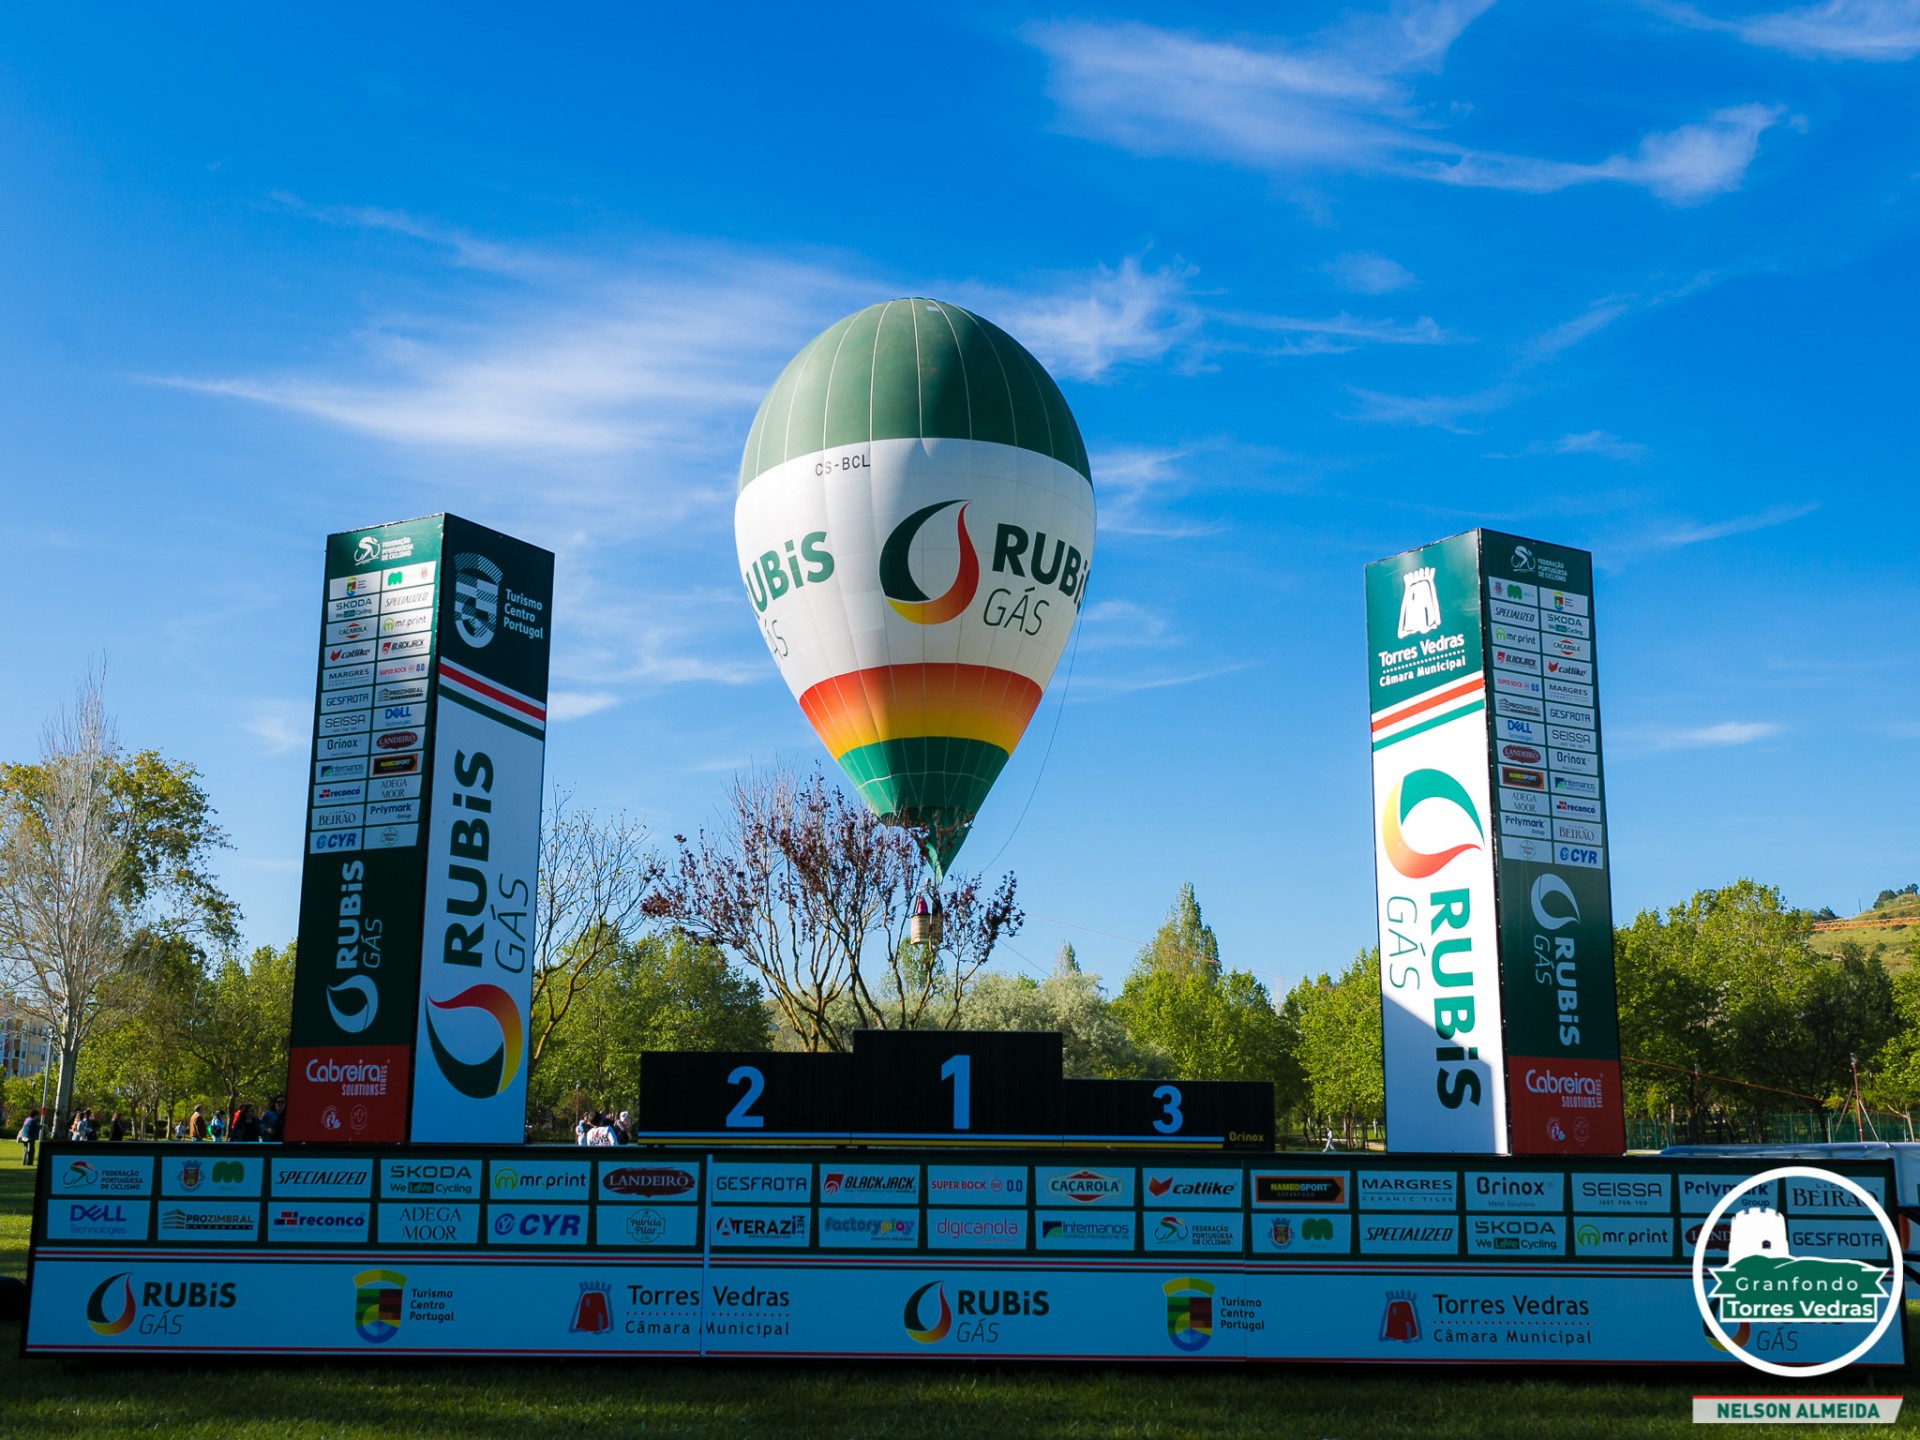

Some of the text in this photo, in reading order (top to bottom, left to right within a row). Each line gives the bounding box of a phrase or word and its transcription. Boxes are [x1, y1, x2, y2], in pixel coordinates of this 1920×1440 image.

[815, 454, 871, 476] CS-BCL
[745, 531, 835, 616] UBiS
[505, 588, 543, 611] Turismo
[504, 602, 535, 622] Centro
[983, 586, 1050, 636] GÁS
[1494, 606, 1535, 623] SPECIALIZED
[503, 616, 543, 639] Portugal
[341, 648, 370, 659] catlike
[1378, 633, 1465, 667] Torres Vedras
[329, 668, 369, 680] MARGRES
[1379, 655, 1466, 687] Câmara Municipal
[1558, 665, 1587, 677] catlike
[1549, 684, 1588, 696] MARGRES
[326, 693, 369, 707] GESFROTA
[385, 706, 412, 719] DELL
[1550, 708, 1591, 723] GESFROTA
[325, 714, 366, 728] SEISSA
[1507, 720, 1532, 734] DELL
[327, 738, 358, 750] Brinox
[1552, 729, 1591, 744] SEISSA
[1556, 751, 1587, 766] Brinox
[331, 788, 360, 798] reconco
[1567, 804, 1596, 814] reconco
[327, 833, 357, 849] CYR
[1571, 848, 1598, 864] CYR
[490, 872, 529, 974] GÁS
[363, 917, 383, 968] GÁS
[1386, 896, 1426, 990] GÁS
[1533, 935, 1555, 985] GÁS
[305, 1058, 380, 1083] Cabreira
[1525, 1068, 1596, 1095] Cabreira
[341, 1083, 379, 1096] SOLUTIONS
[725, 1065, 765, 1128] 2
[940, 1054, 971, 1130] 1
[1152, 1085, 1184, 1135] 3
[1229, 1131, 1264, 1142] Brinox
[274, 1170, 368, 1185] SPECIALIZED
[519, 1172, 587, 1189] mr.print
[609, 1174, 689, 1187] LANDEIRO
[716, 1176, 807, 1191] GESFROTA
[844, 1176, 915, 1190] BLACKJACK
[1361, 1179, 1453, 1190] MARGRES
[390, 1183, 472, 1194] We Cycling
[931, 1180, 959, 1190] SUPER
[961, 1181, 986, 1190] BOCK
[1006, 1179, 1023, 1192] 0.0
[1051, 1180, 1120, 1193] CAÇAROLA
[1173, 1181, 1235, 1195] catlike
[1270, 1183, 1328, 1192] NAMEDSPORT
[1477, 1176, 1545, 1195] Brinox
[1582, 1182, 1662, 1198] SEISSA
[1741, 1199, 1770, 1208] Group
[70, 1204, 127, 1222] DELL
[186, 1214, 254, 1224] PROZIMBRAL
[300, 1215, 365, 1226] reconco
[400, 1207, 462, 1222] ADEGA
[70, 1224, 127, 1235] Technologies
[519, 1213, 582, 1236] CYR
[824, 1216, 915, 1235] factoryplay
[937, 1218, 1018, 1239] digicanola
[1063, 1221, 1129, 1234] Intermanos
[402, 1225, 457, 1241] MOOR
[1364, 1227, 1454, 1241] SPECIALIZED
[1602, 1228, 1668, 1246] mr.print
[1792, 1231, 1884, 1247] GESFROTA
[1476, 1239, 1557, 1250] We Cycling
[142, 1281, 238, 1308] RUBiS
[411, 1288, 453, 1299] Turismo
[627, 1284, 790, 1307] Torres Vedras
[410, 1300, 446, 1310] Centro
[957, 1289, 1050, 1317] RUBiS
[1220, 1296, 1262, 1308] Turismo
[1432, 1293, 1590, 1316] Torres Vedras
[409, 1311, 454, 1324] Portugal
[1220, 1308, 1255, 1319] Centro
[139, 1309, 184, 1335] GÁS
[625, 1320, 690, 1335] Câmara
[1220, 1319, 1265, 1332] Portugal
[956, 1317, 1001, 1343] GÁS
[1433, 1329, 1592, 1346] Câmara Municipal
[1756, 1326, 1799, 1351] GÁS
